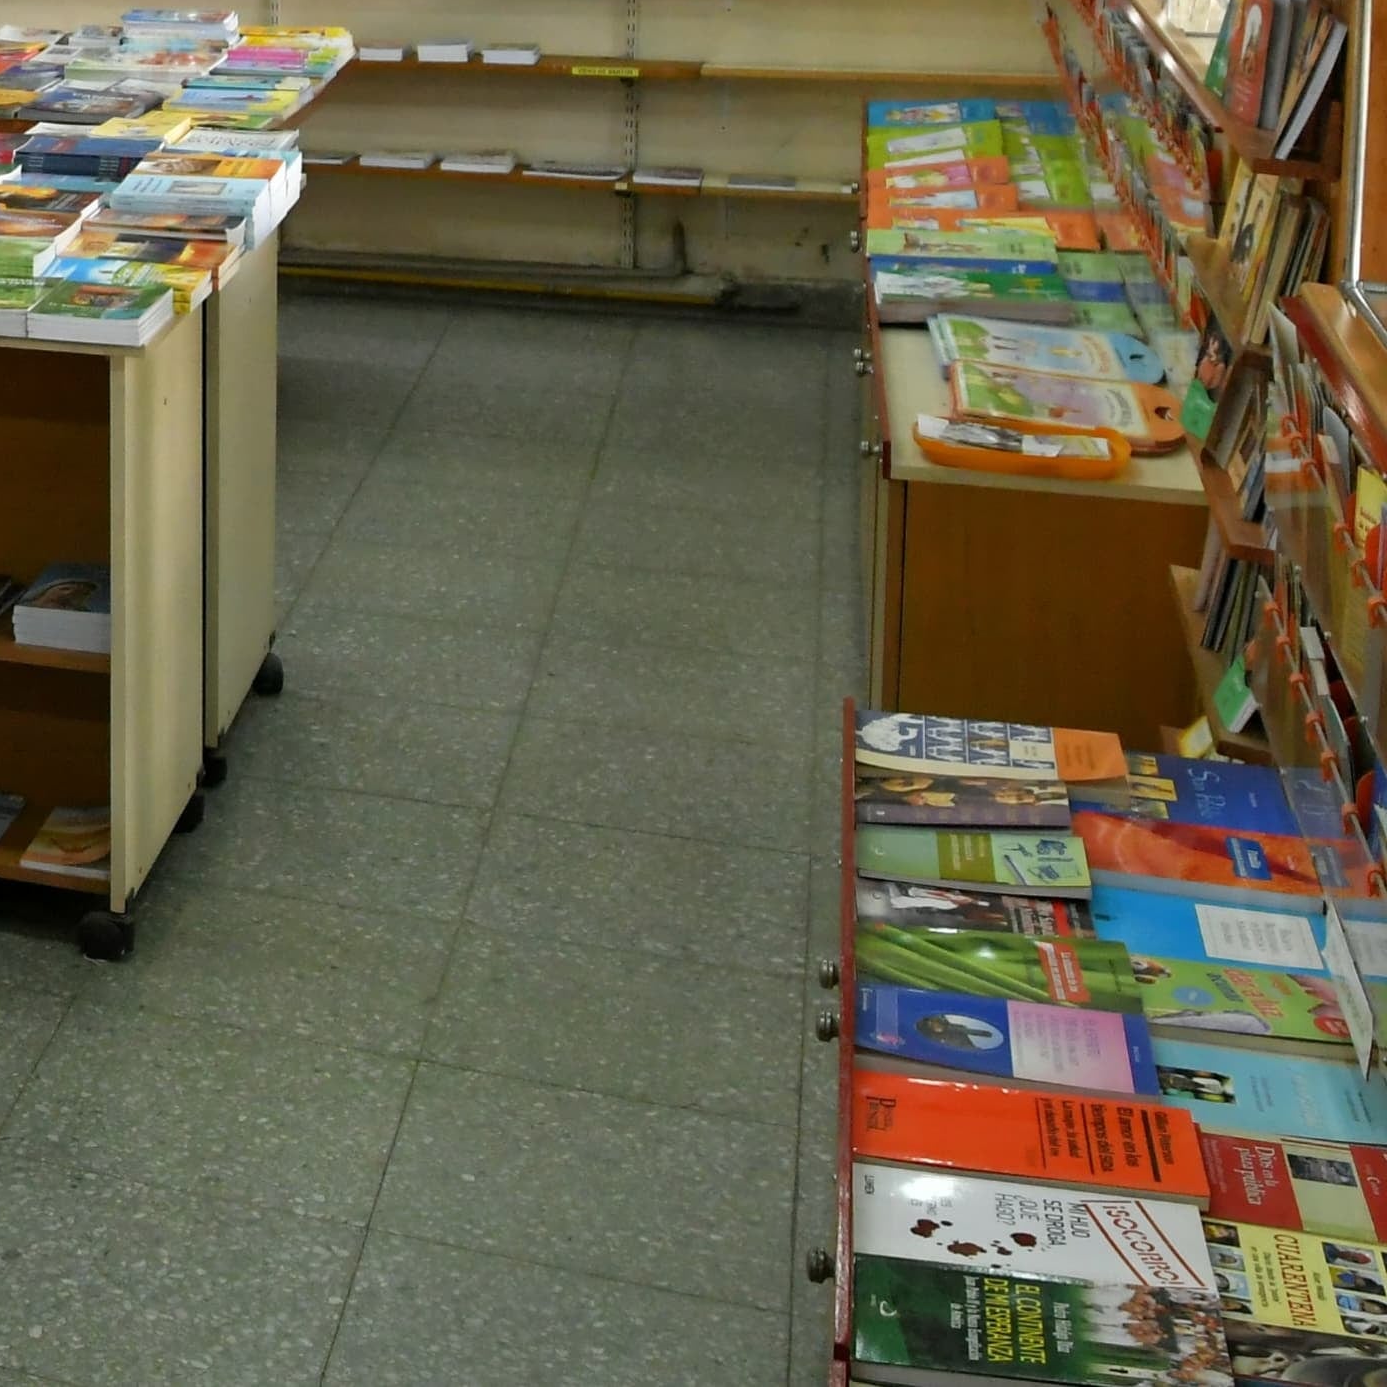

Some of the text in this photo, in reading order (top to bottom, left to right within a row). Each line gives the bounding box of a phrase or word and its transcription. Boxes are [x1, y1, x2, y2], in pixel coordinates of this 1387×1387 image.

[1088, 1103, 1109, 1138] tiempos
[1116, 1107, 1142, 1167] El amor en los
[1095, 1138, 1112, 1153] del
[1255, 1145, 1277, 1169] Dios
[994, 1193, 1018, 1227] HAGO?
[1043, 1198, 1062, 1212] SE
[1069, 1203, 1090, 1239] MI HIJO
[1102, 1203, 1184, 1287] ¡SOCORRO!
[1273, 1233, 1318, 1326] CUARENTENA
[984, 1278, 1015, 1362] DE MI ESPERANZA
[1015, 1284, 1046, 1364] EL CONTINENTE
